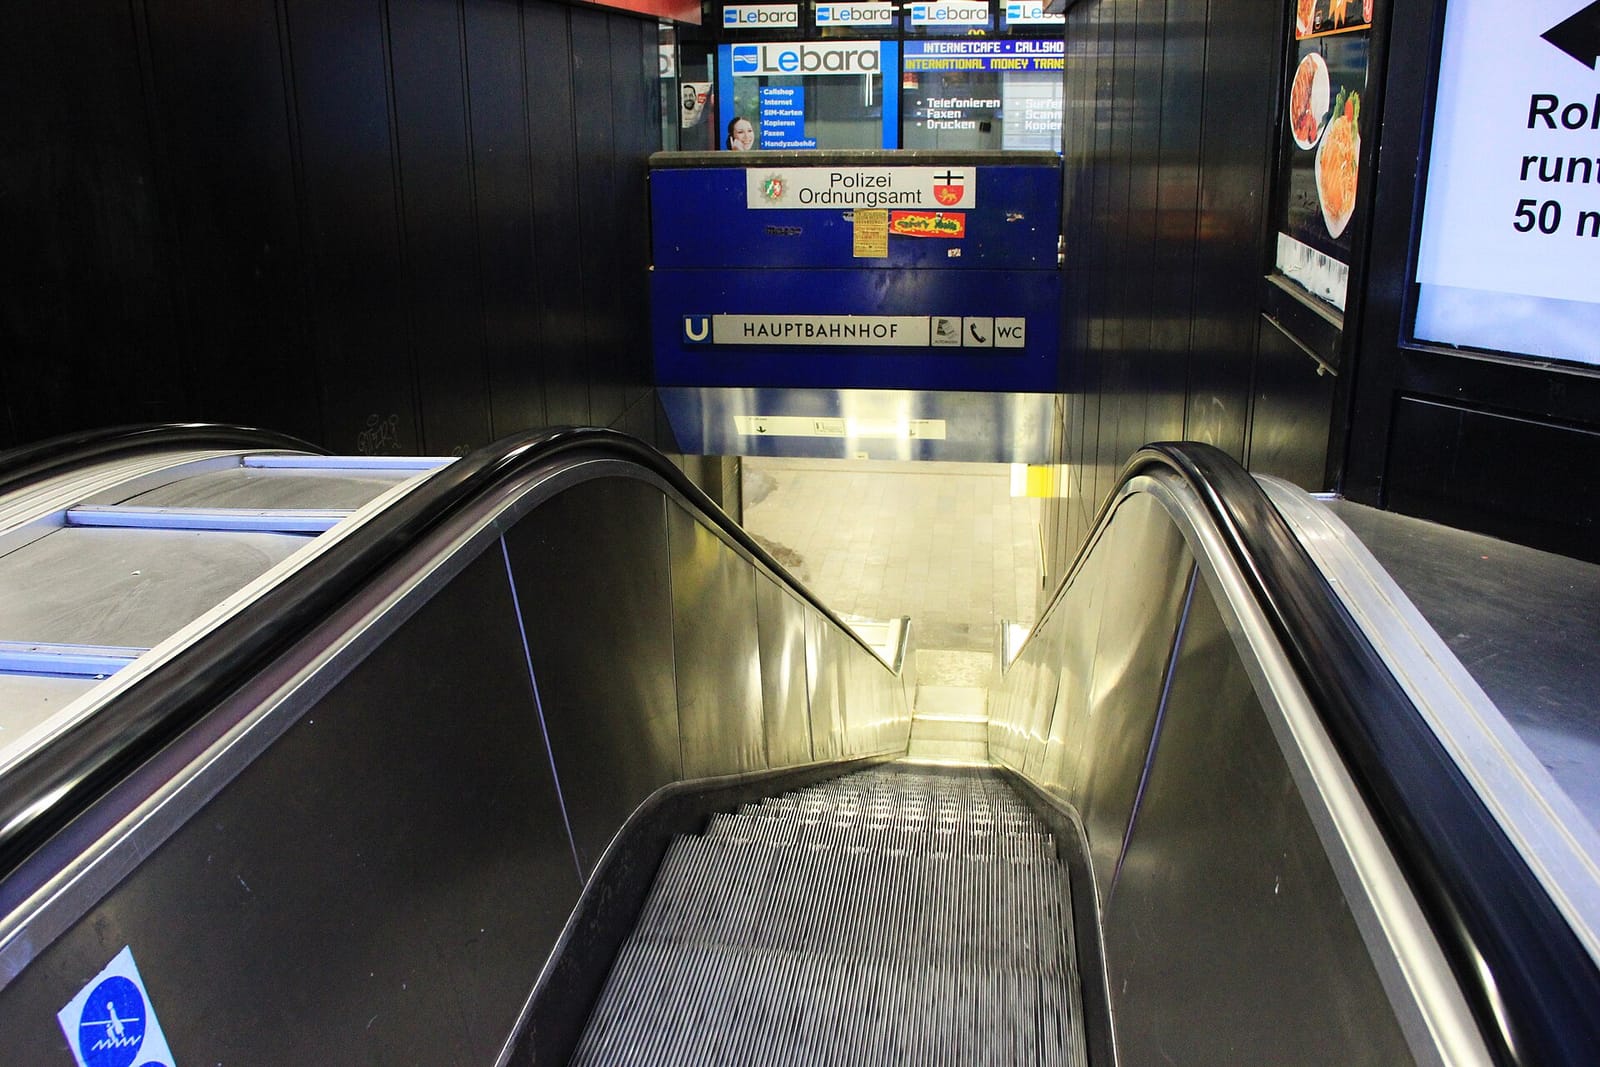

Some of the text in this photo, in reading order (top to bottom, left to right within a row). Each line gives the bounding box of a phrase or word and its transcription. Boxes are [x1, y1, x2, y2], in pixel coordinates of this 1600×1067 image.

[739, 9, 797, 23] Lebara
[832, 7, 891, 21] Lebara
[927, 6, 988, 20] Lebara
[923, 41, 1064, 53] INTERNETCAFE CALLSHO
[762, 45, 879, 72] Lebara
[905, 58, 986, 69] INTERNATIONAL
[990, 58, 1028, 69] MONEY
[763, 88, 795, 96] Callshop
[927, 98, 1001, 108] Telefonieren
[927, 109, 962, 119] Faxen
[927, 120, 976, 129] Drucken
[764, 140, 816, 148] Handyzubehör
[830, 172, 892, 188] Polizei
[799, 187, 922, 207] Ordnungsamt
[1513, 198, 1562, 235] 50
[685, 318, 709, 341] U
[743, 322, 899, 339] HAUPTBAHNHOF
[997, 326, 1022, 339] WC
